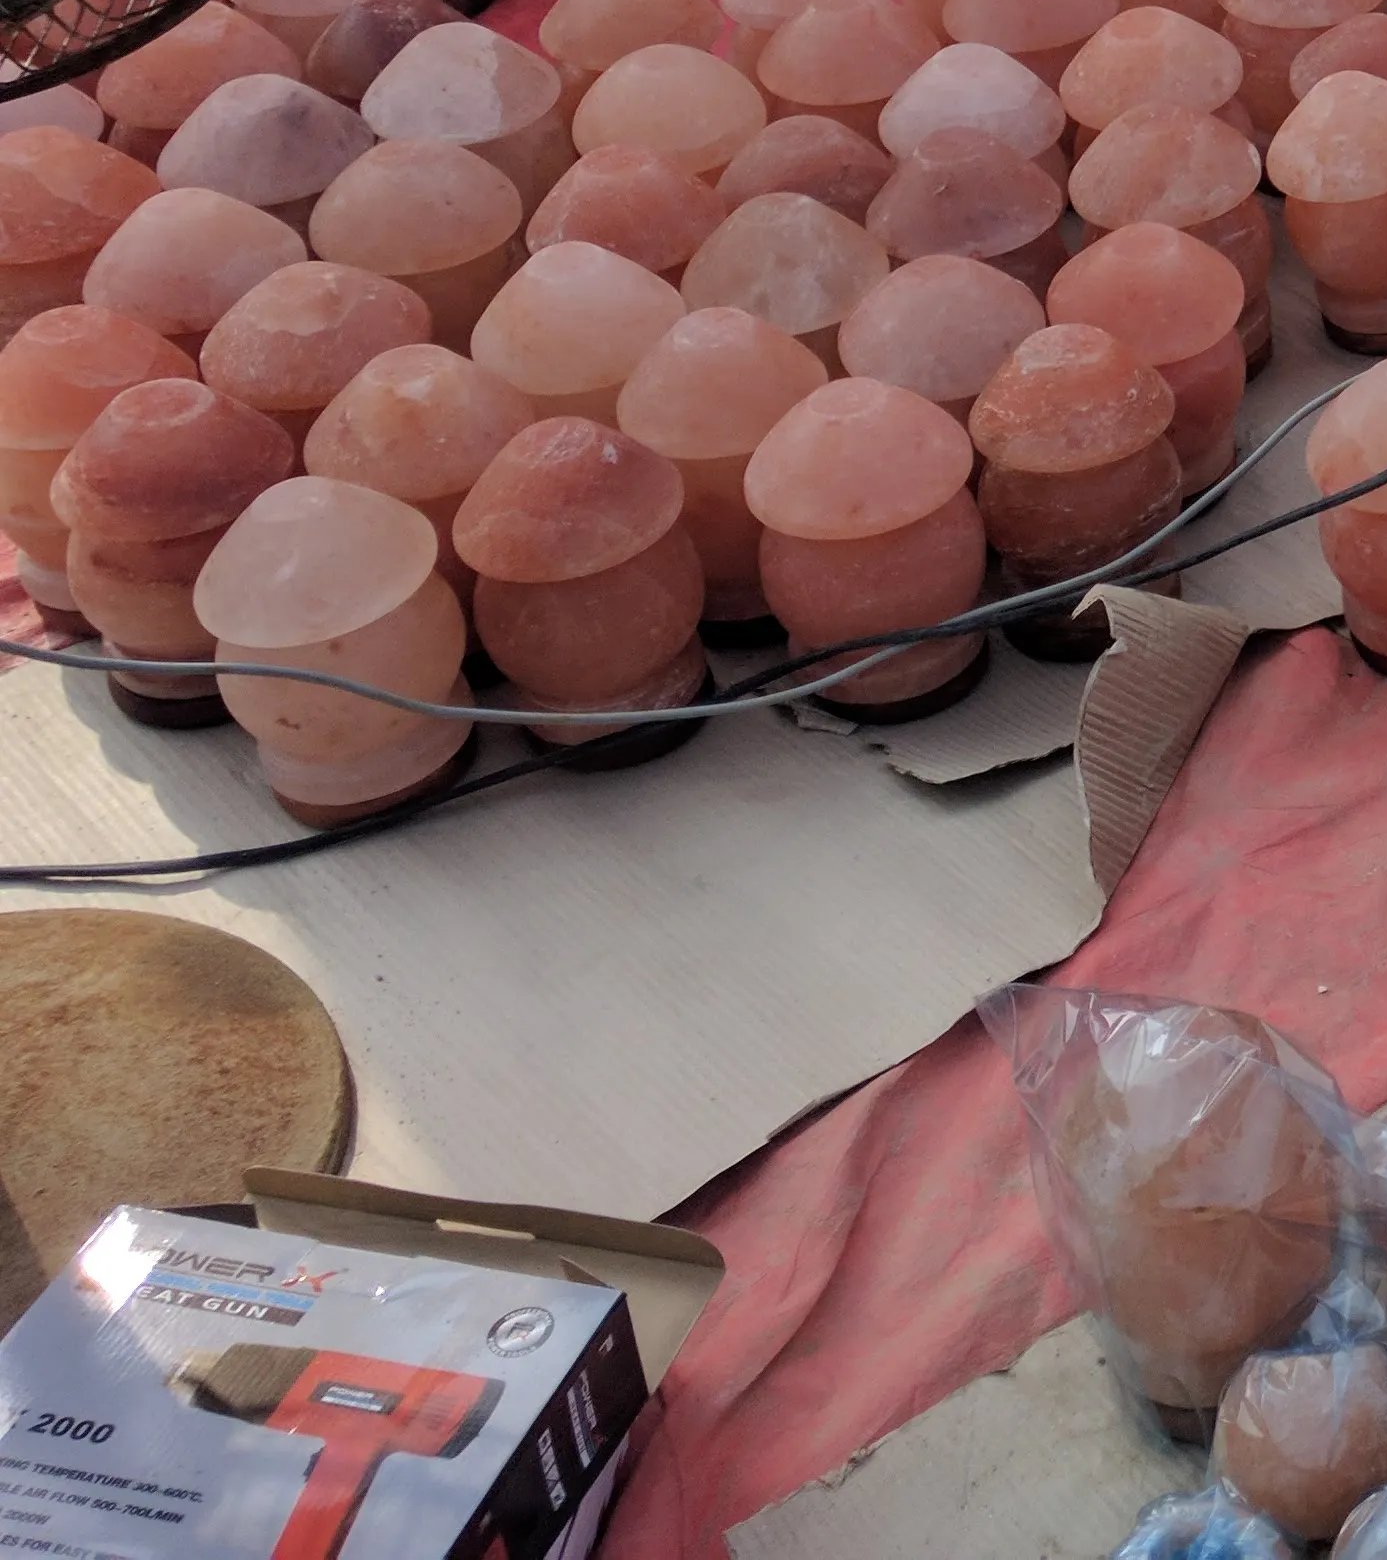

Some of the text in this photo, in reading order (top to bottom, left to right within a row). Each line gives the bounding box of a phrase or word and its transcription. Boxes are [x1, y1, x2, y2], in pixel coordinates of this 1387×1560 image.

[157, 1247, 276, 1283] OWER
[137, 1285, 270, 1320] EAT GUN
[27, 1412, 116, 1445] 2000
[32, 1462, 133, 1490] TEMPERATURE
[0, 1481, 22, 1496] LE
[22, 1487, 49, 1500] AIR
[49, 1490, 91, 1508] FLOW
[21, 1538, 53, 1552] FOR
